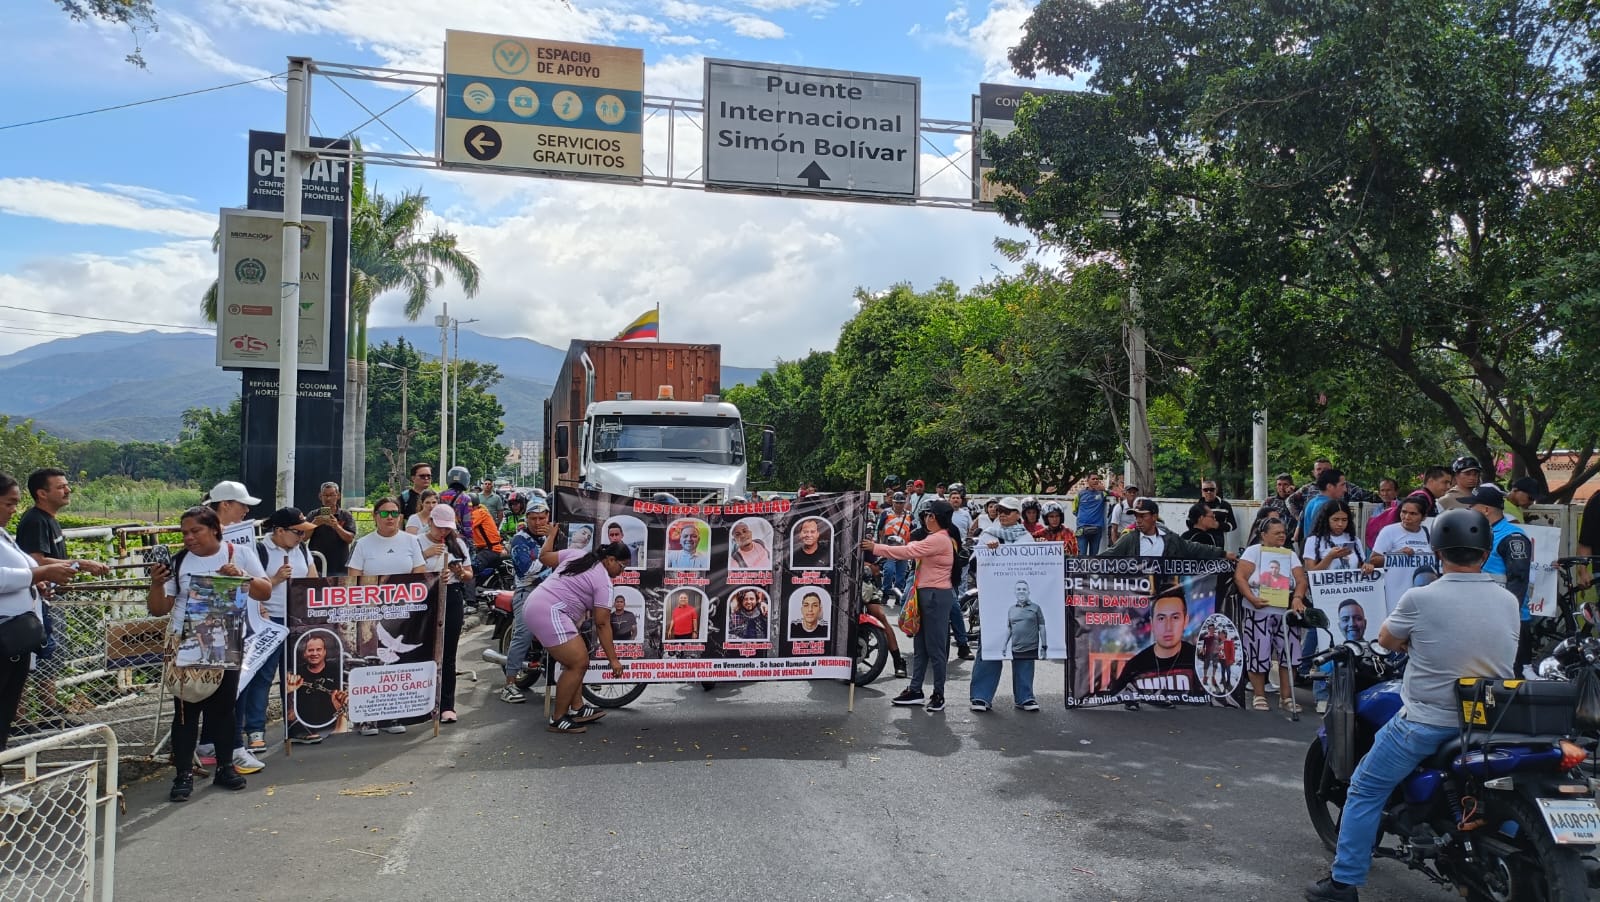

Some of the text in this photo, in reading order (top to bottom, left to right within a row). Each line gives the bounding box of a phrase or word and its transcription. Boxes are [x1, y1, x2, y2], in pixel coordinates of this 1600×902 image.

[537, 47, 591, 63] ESPACIO
[537, 62, 600, 78] DE APOYO
[767, 75, 862, 100] Puente
[720, 101, 901, 132] Internacional
[537, 134, 621, 151] SERVICIOS
[718, 129, 907, 162] Simón Bolívar
[533, 149, 625, 168] GRATUITOS
[253, 188, 344, 202] ATENCIO FRONTERAS
[249, 380, 337, 390] REPÚBLIC COLOMBIA
[633, 499, 791, 515] ROSTROS DE LIBERTAD
[1066, 558, 1139, 573] EXIGIMOS
[1142, 559, 1161, 574] LA
[1386, 555, 1423, 568] DANNER
[1065, 577, 1151, 591] DE MI HIJO
[1313, 569, 1382, 586] LIBERTAD
[307, 582, 428, 608] LIBERTAD
[1320, 585, 1374, 595] PARA DANNER
[1065, 594, 1149, 608] ARLEI DANILO
[337, 606, 380, 616] Ciudadano
[381, 603, 428, 614] Colombiano
[1085, 612, 1132, 625] ESPITIA
[630, 662, 665, 670] DETENIDOS
[665, 661, 712, 670] INJUSTAMENTE
[379, 672, 412, 683] JAVIER
[602, 671, 631, 679] GUSVO
[632, 671, 651, 679] PETRO
[656, 671, 696, 679] CANCILLERIA
[697, 670, 737, 678] COLOMBIANA
[742, 669, 772, 677] GOBIERNO
[781, 668, 813, 676] VENEZUELA
[351, 683, 398, 695] GIRALDO
[1120, 693, 1130, 702] lo
[1133, 692, 1165, 703] Espera
[1167, 694, 1180, 703] en
